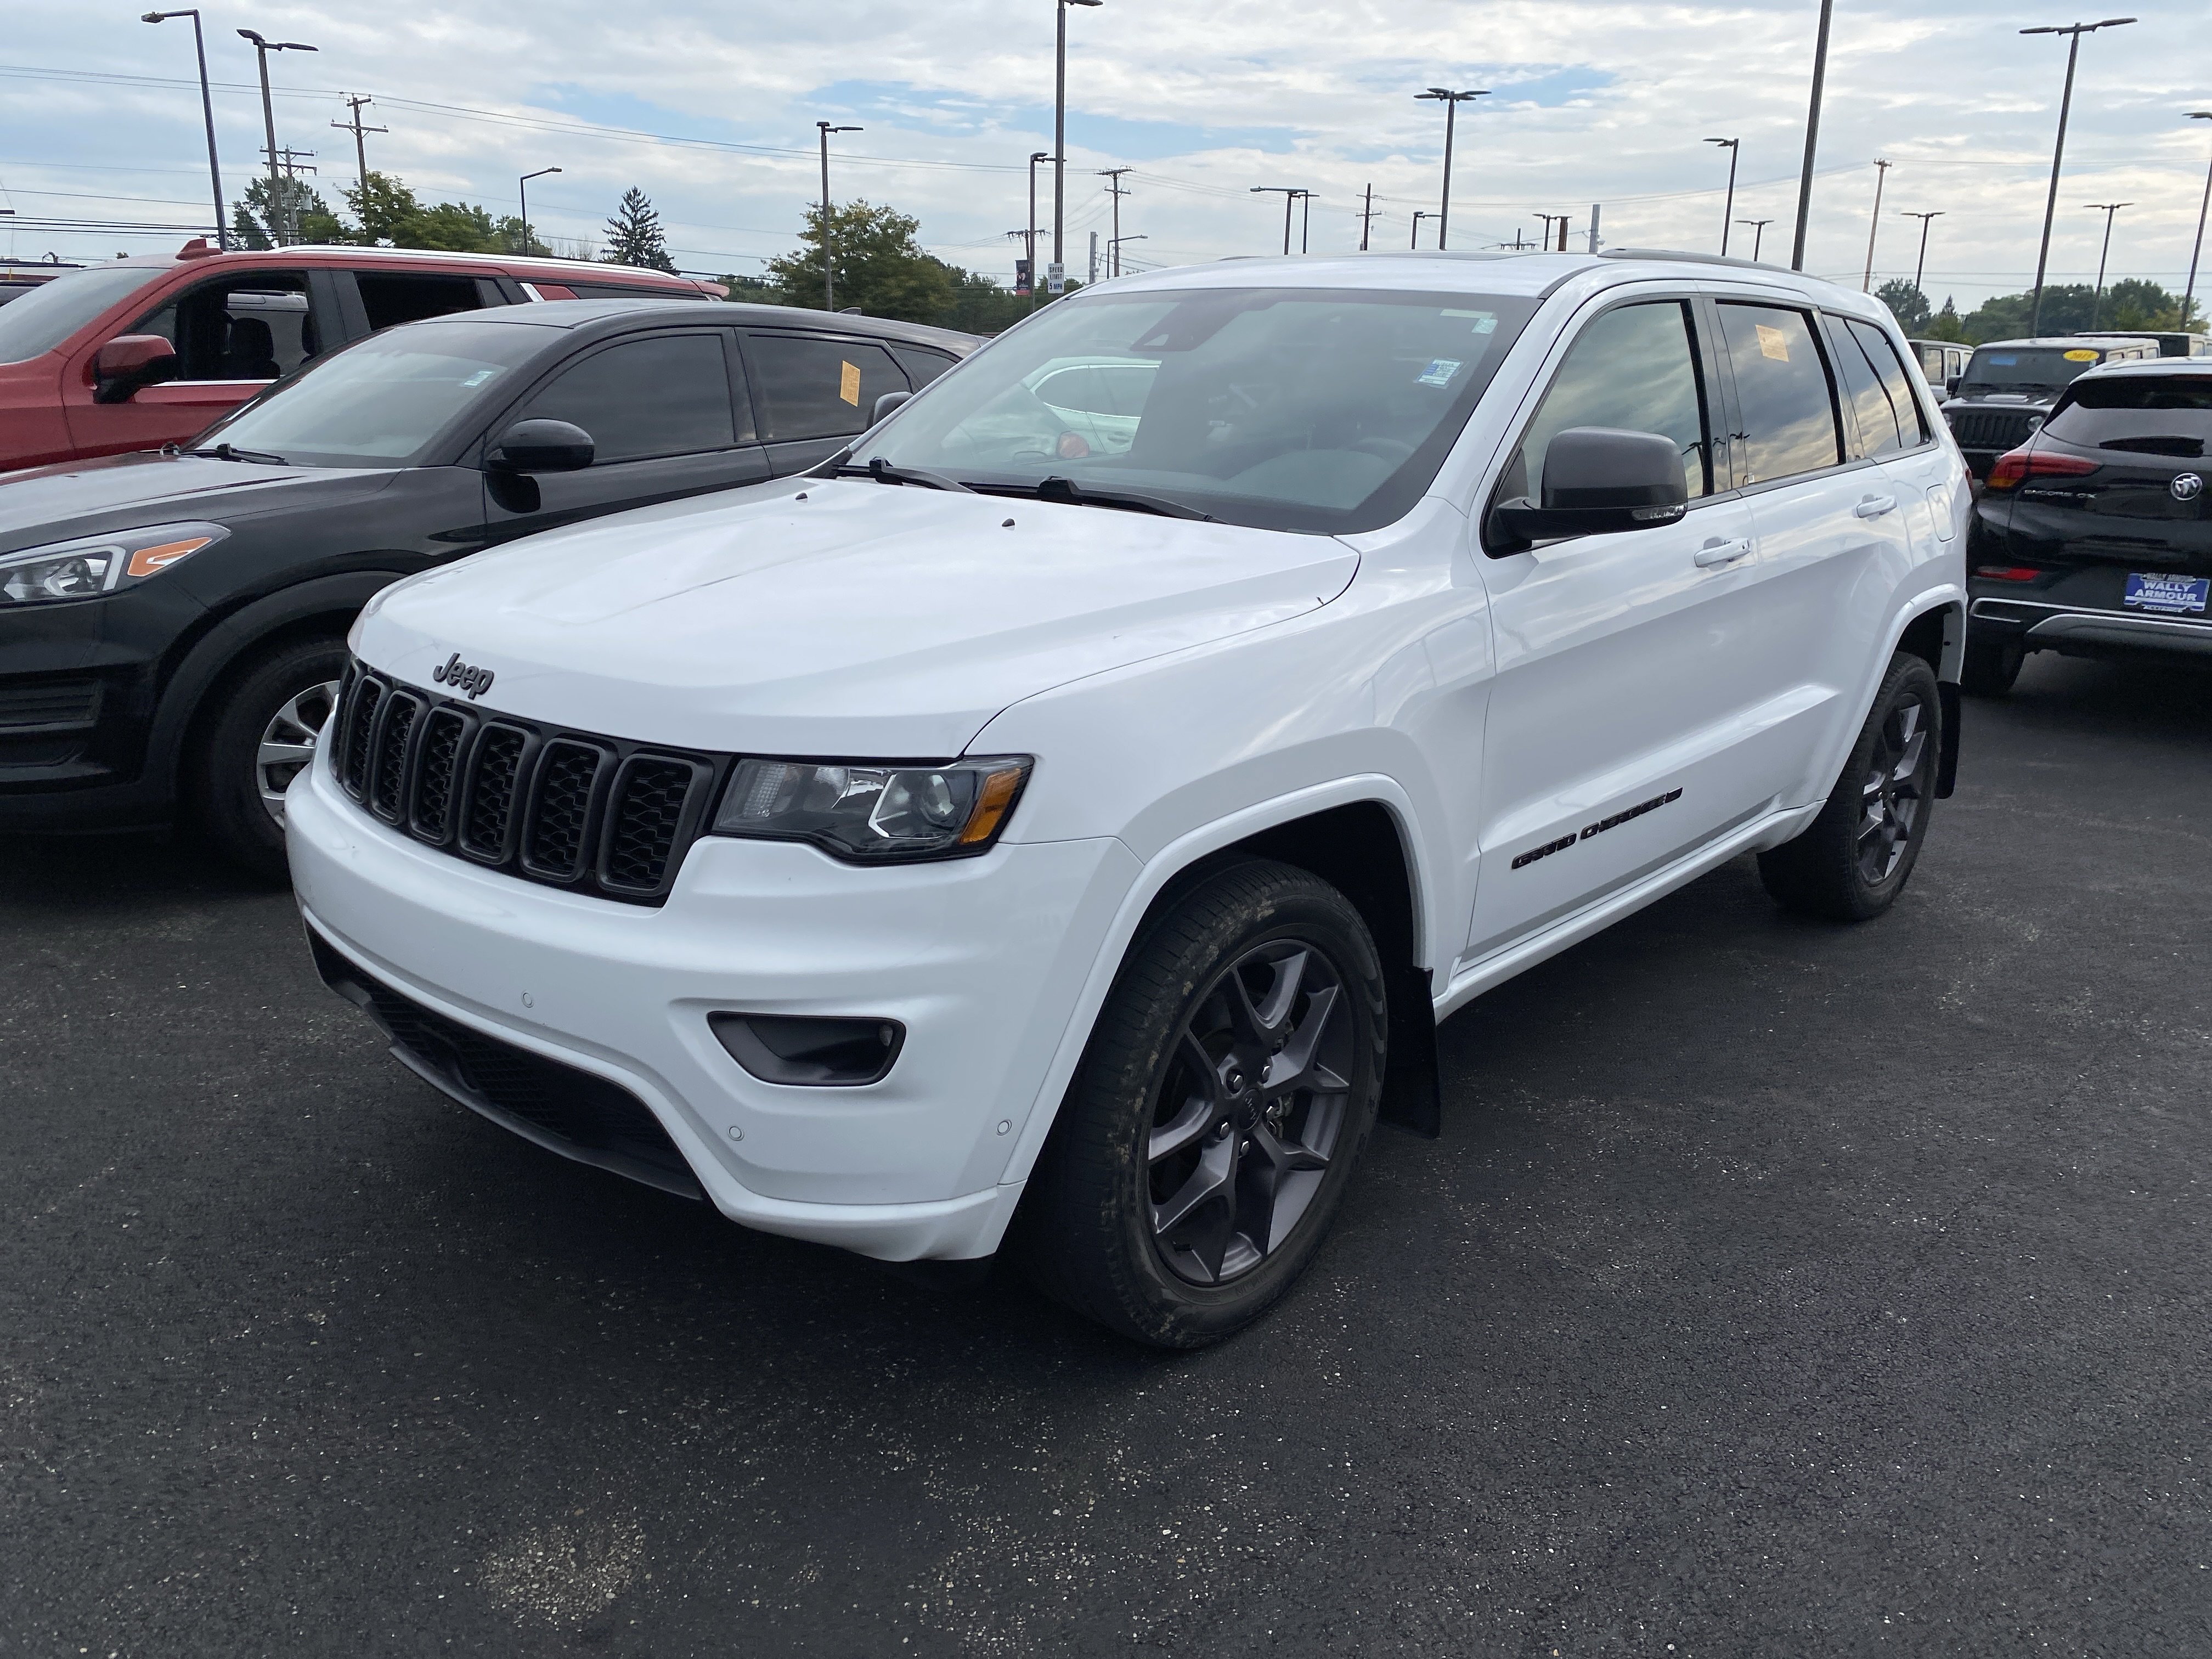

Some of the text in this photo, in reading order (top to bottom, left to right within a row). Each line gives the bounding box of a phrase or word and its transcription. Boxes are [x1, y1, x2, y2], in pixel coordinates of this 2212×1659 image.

[2134, 589, 2197, 601] ARMOUR
[2144, 581, 2197, 592] WALLY
[433, 652, 494, 700] Jeep
[1511, 786, 1683, 870] GRAND CHEROKEE
